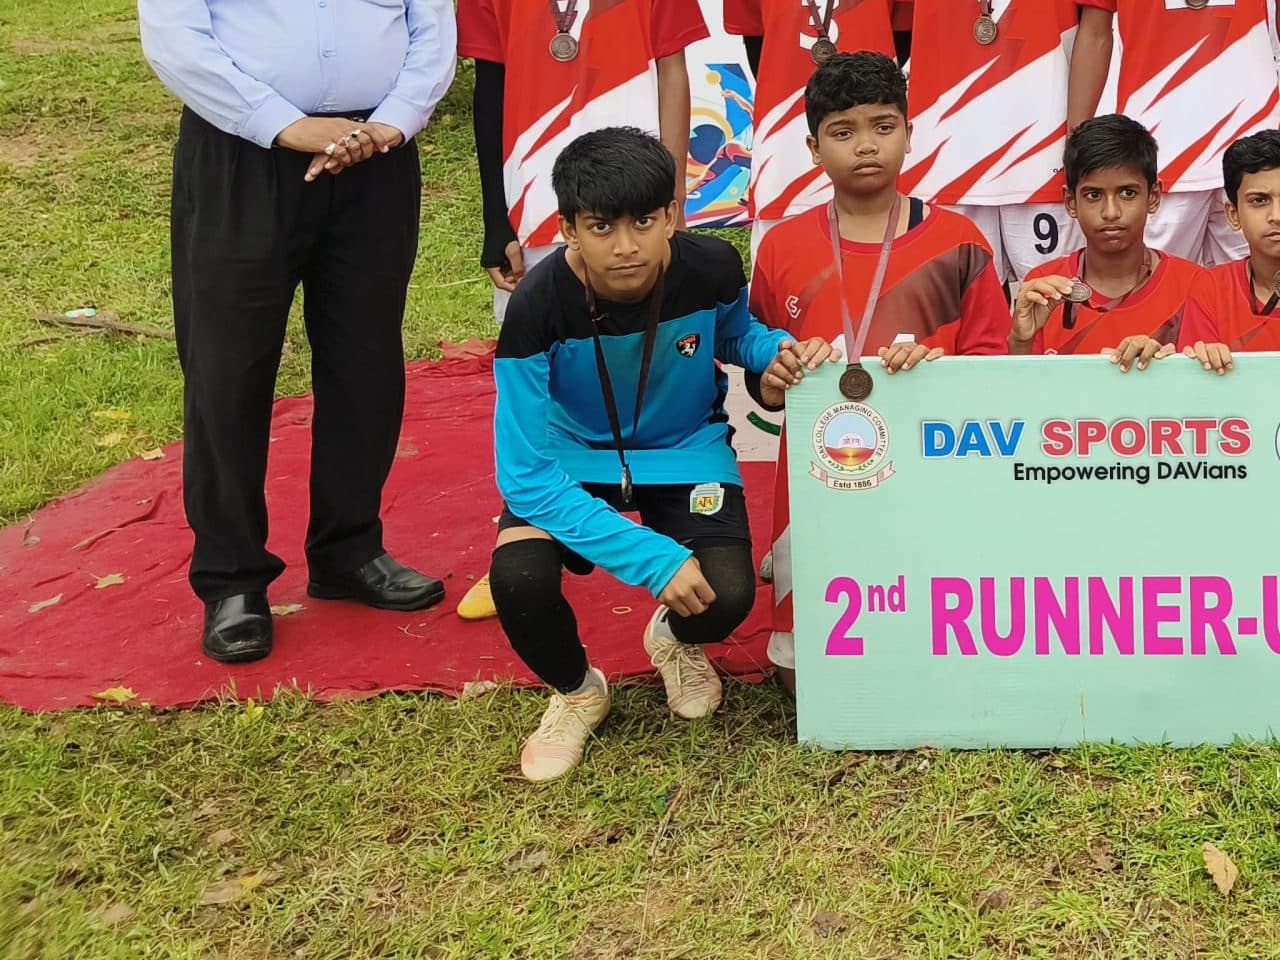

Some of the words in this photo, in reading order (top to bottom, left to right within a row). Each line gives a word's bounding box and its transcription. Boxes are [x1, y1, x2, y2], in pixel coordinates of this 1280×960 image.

[1033, 212, 1059, 255] 9
[923, 421, 1025, 458] DAV
[1042, 419, 1251, 456] SPORTS
[1014, 461, 1150, 485] Empowering
[1157, 460, 1248, 481] DAVians
[825, 575, 906, 656] 2nd
